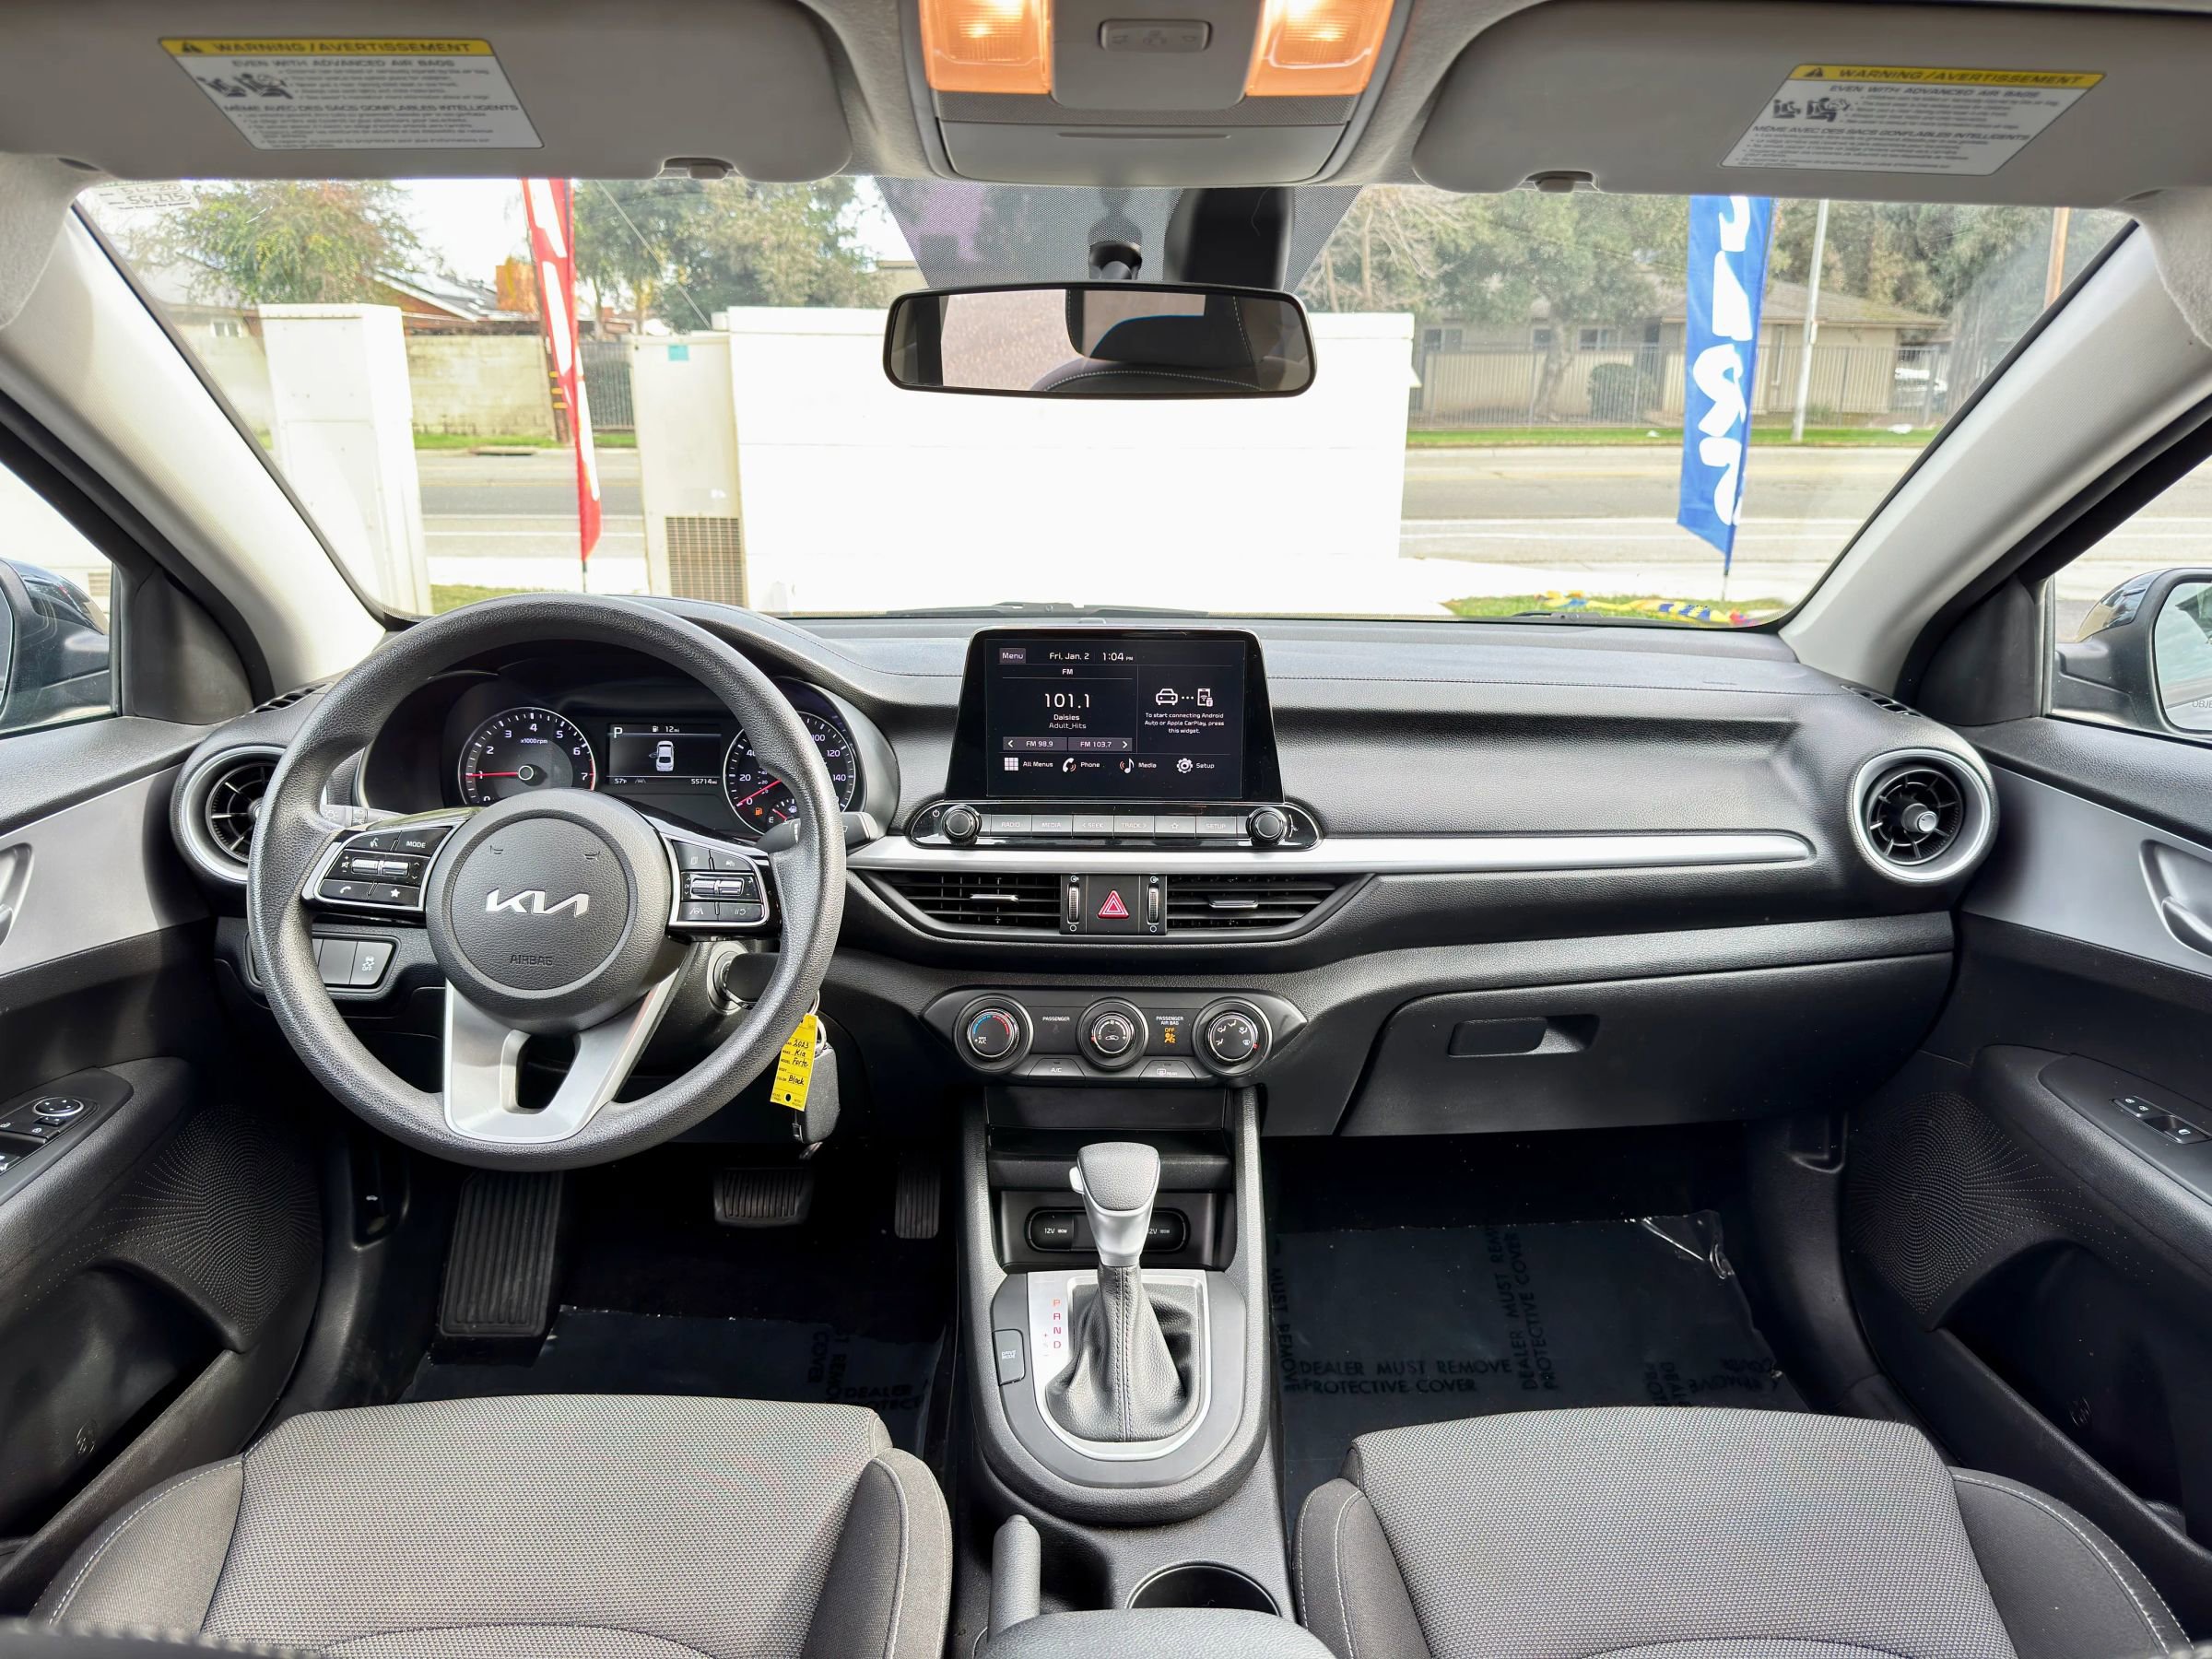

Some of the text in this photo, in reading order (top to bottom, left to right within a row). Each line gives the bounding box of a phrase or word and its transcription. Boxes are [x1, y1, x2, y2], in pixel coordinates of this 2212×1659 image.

[215, 42, 306, 53] WARNING
[319, 42, 471, 53] AVERTISSEMENT
[232, 59, 455, 67] EVEN WITH ADVANCED AIR BAGS
[1840, 69, 1923, 80] WARNING
[1932, 71, 2084, 85] AVERTISSEMENT
[1903, 88, 1973, 96] ADVANCED
[1002, 652, 1023, 660] Menu
[1065, 653, 1082, 661] Jan.
[1102, 653, 1124, 661] 1:04
[1044, 693, 1089, 709] 101.1
[529, 724, 538, 733] 4
[1049, 722, 1087, 730] Adult_Hits
[505, 730, 512, 738] 3
[557, 730, 563, 739] 5
[614, 726, 623, 738] P
[811, 734, 826, 742] 100
[486, 746, 494, 755] 2
[573, 747, 581, 756] 6
[826, 749, 841, 758] 120
[581, 772, 588, 782] 7
[739, 773, 751, 782] 20
[833, 773, 846, 782] 140
[746, 797, 753, 806] 0
[406, 840, 427, 849] MODE
[486, 887, 590, 919] KIA
[510, 953, 553, 966] AIRBAG
[793, 1039, 810, 1049] 2023
[794, 1049, 806, 1058] Kia
[792, 1056, 809, 1067] Forte
[788, 1075, 805, 1086] Black
[1045, 1227, 1055, 1235] 12V
[1495, 1274, 1521, 1319] MUST
[1053, 1299, 1061, 1307] P
[1504, 1232, 1558, 1391] PROTECTIVE COVER
[1053, 1326, 1062, 1335] N
[1053, 1340, 1062, 1348] D
[1511, 1330, 1538, 1391] DEALER
[1298, 1359, 1512, 1376] DEALER MUST REMOVE
[1301, 1378, 1477, 1394] PROTECTIVE COVER
